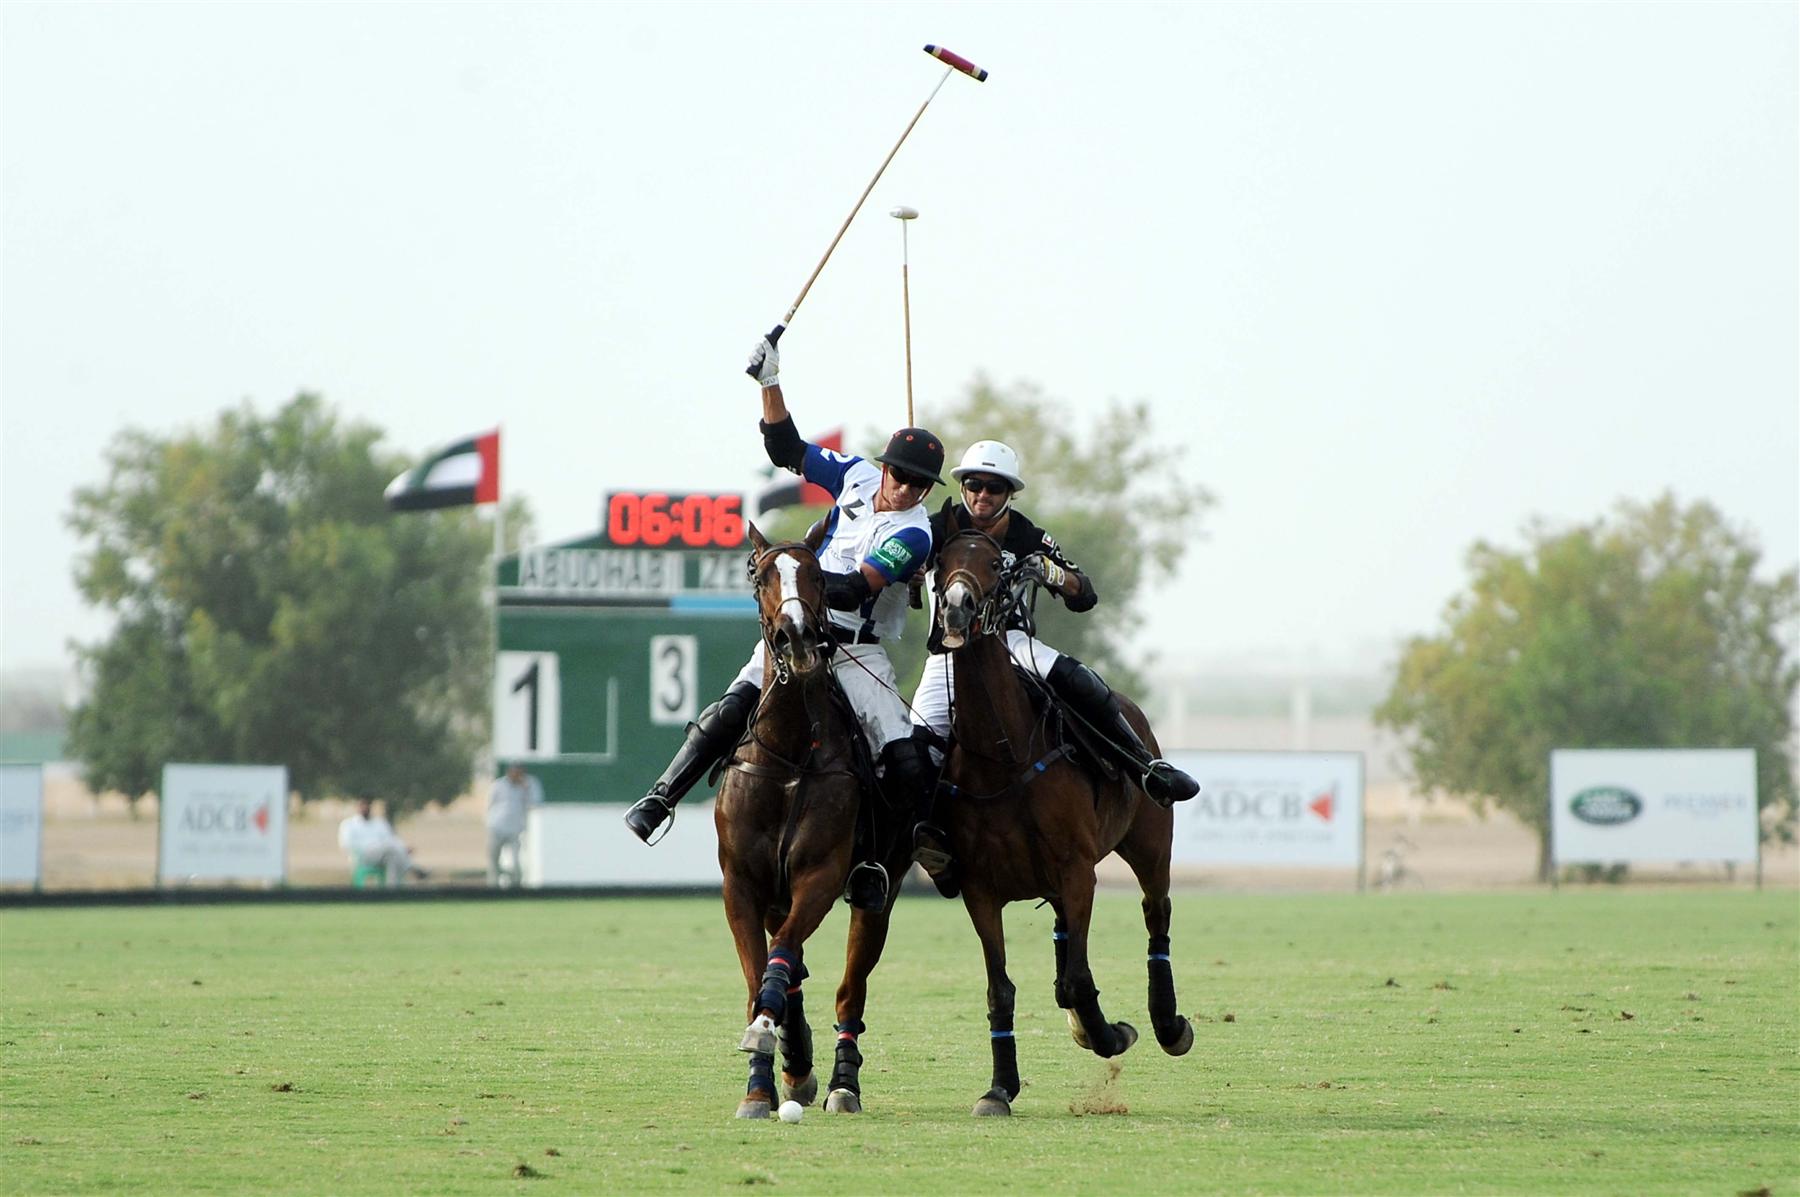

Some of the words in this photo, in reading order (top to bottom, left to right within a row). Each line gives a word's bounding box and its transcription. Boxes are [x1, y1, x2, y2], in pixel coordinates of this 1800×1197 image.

[608, 491, 745, 547] 06:06
[511, 658, 540, 752] 1
[661, 644, 685, 713] 3
[178, 802, 249, 832] ADCB
[1191, 790, 1303, 821] ADCB
